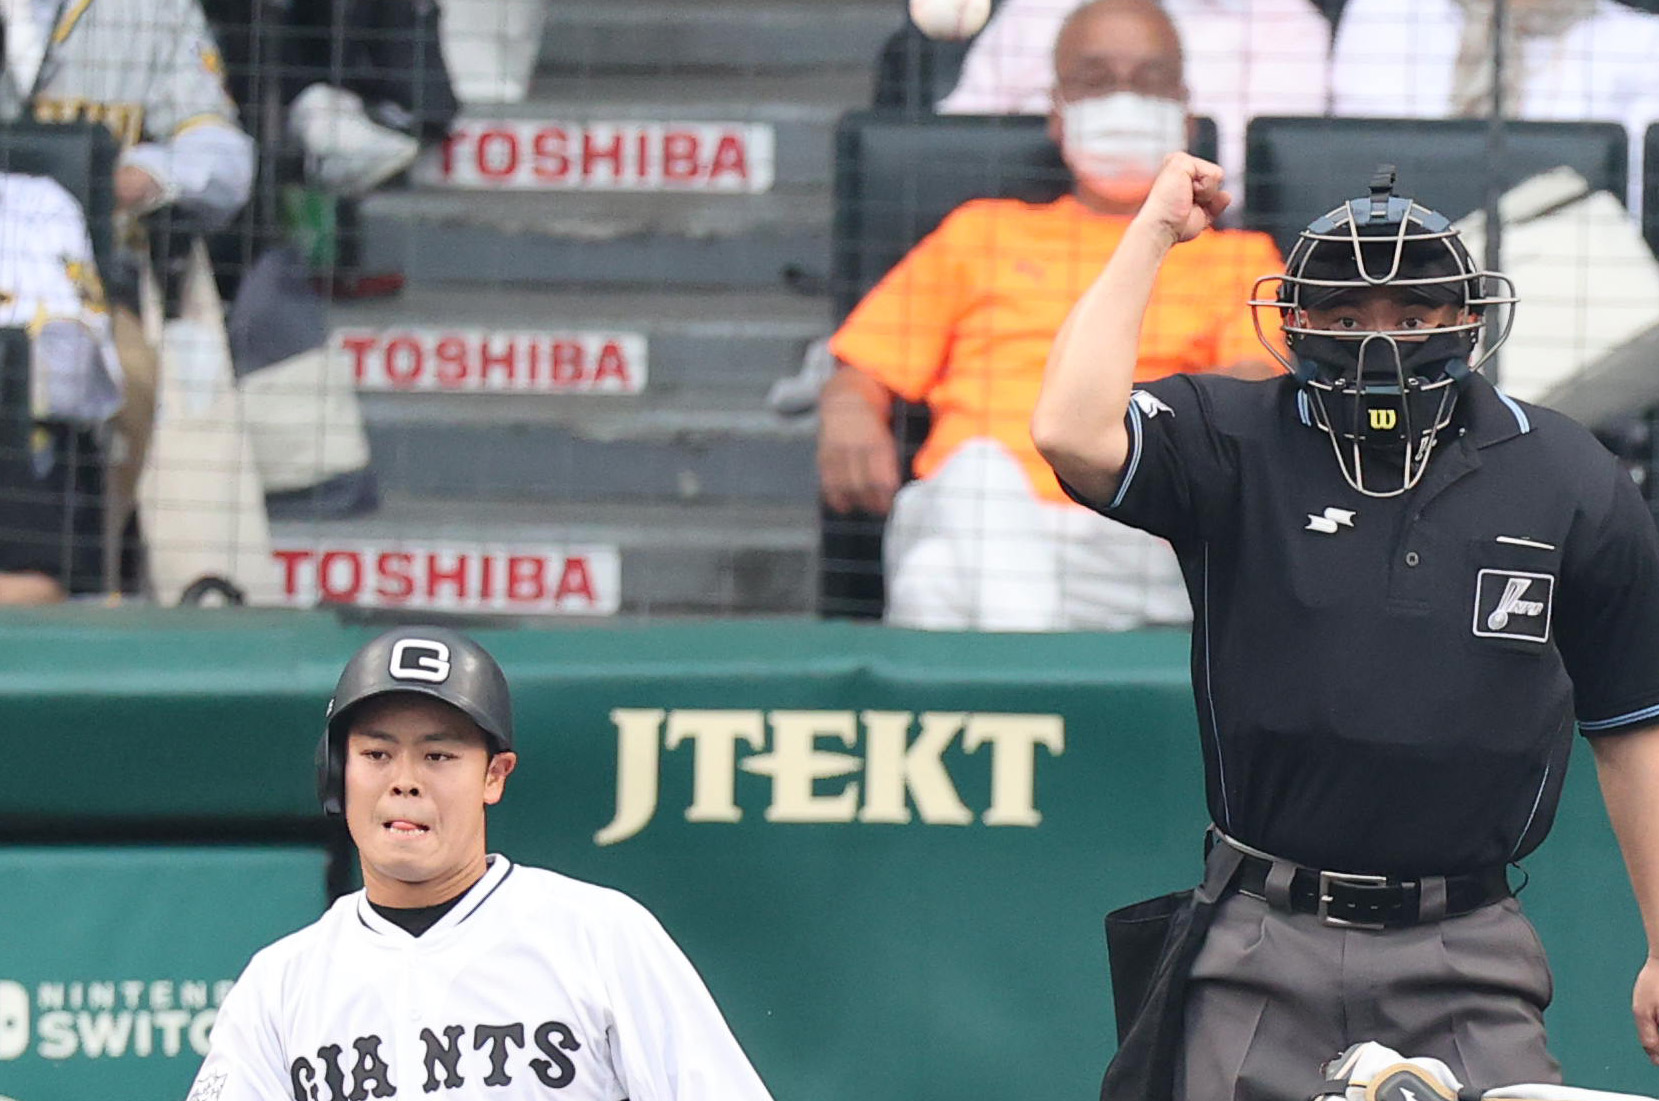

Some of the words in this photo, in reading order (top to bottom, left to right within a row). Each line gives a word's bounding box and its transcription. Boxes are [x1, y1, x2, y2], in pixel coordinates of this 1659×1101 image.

[441, 129, 747, 179] TOSHIBA
[343, 337, 632, 388] TOSHIBA
[272, 550, 596, 604] TOSHIBA
[389, 638, 451, 683] G
[593, 708, 1065, 846] JTEKT
